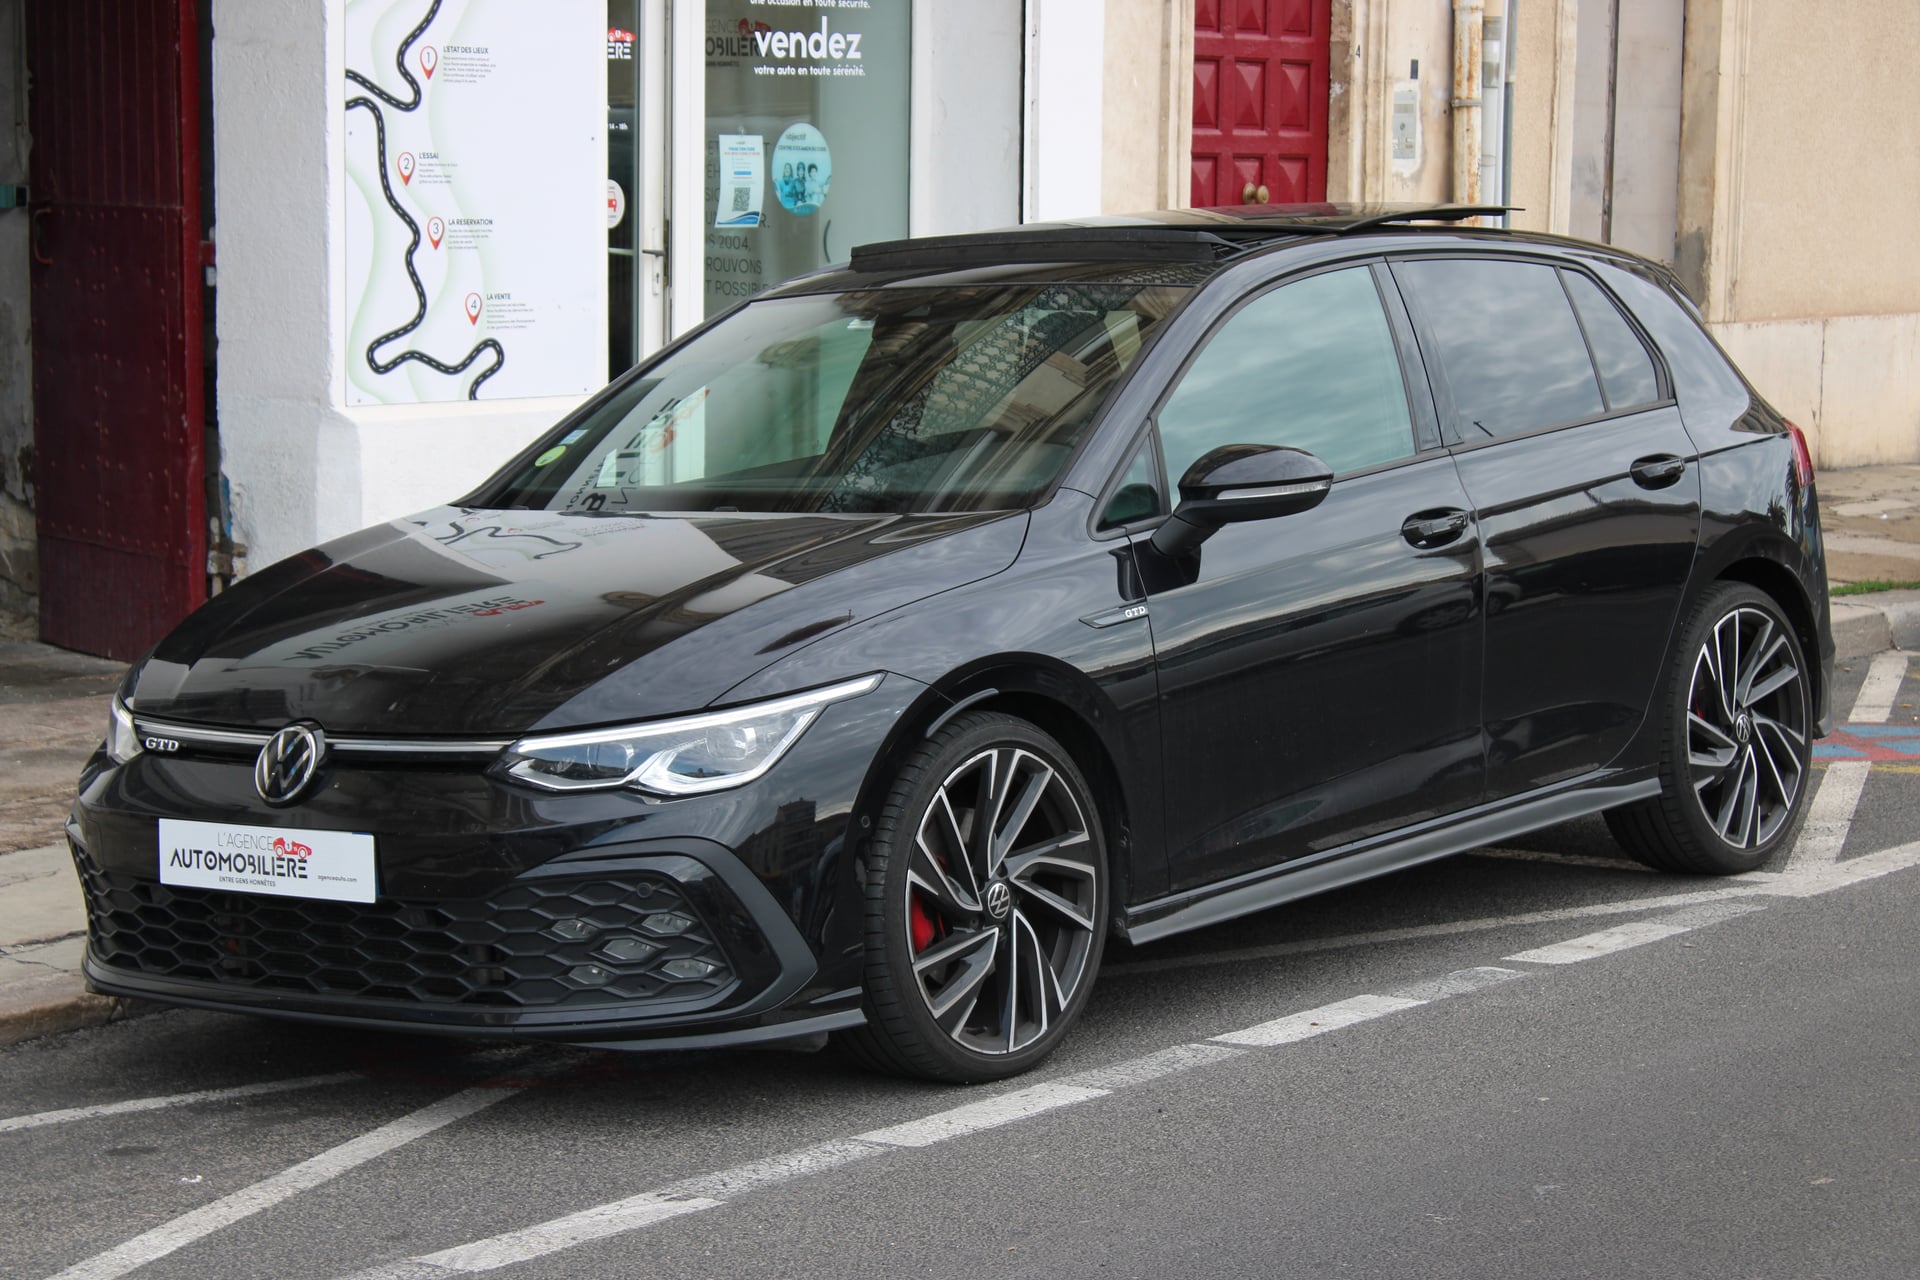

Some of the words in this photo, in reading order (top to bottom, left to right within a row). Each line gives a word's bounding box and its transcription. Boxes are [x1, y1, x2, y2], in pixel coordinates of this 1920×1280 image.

[754, 15, 862, 59] vendez
[461, 46, 472, 54] DES
[753, 64, 776, 76] votre
[776, 64, 796, 76] auto
[797, 66, 808, 76] en
[809, 65, 831, 76] toute
[833, 64, 866, 77] sérénité.
[403, 157, 410, 170] 2
[433, 222, 440, 235] 3
[448, 218, 456, 226] LA
[456, 218, 493, 226] RESERVATION
[486, 293, 494, 301] LA
[494, 293, 511, 301] VENTE
[470, 299, 477, 310] 4
[1124, 605, 1146, 618] GTD
[145, 736, 179, 751] GTD
[217, 832, 274, 852] L'AGENCE
[170, 848, 308, 879] AUTOMOBILIERE
[219, 876, 234, 884] ENTRE
[235, 877, 249, 885] GENS
